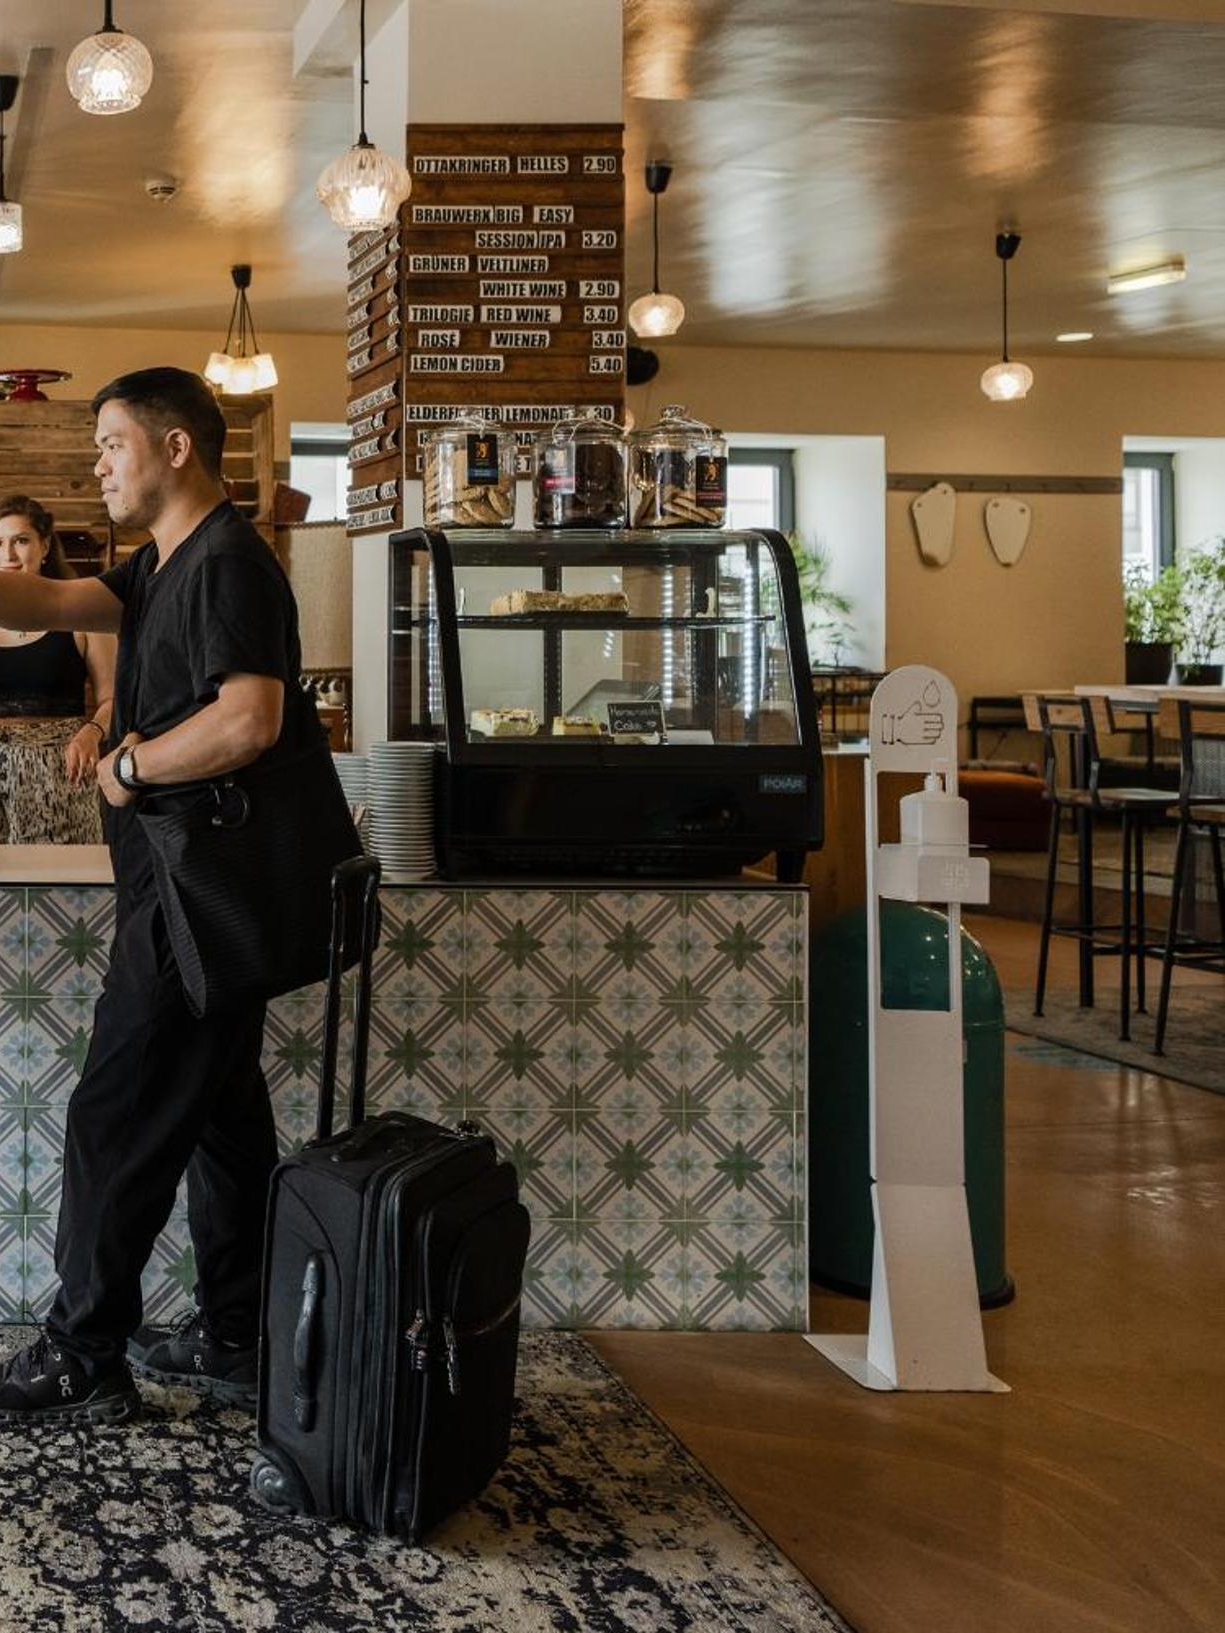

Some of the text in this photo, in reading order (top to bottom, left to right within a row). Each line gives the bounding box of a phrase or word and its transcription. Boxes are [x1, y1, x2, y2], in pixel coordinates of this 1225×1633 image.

[415, 157, 615, 173] OTTAKRINGER HELLES 2.90
[415, 208, 571, 222] BRAUWERK BIG EASY
[478, 233, 614, 248] SESSION IPA 3.20
[479, 257, 546, 272] VELTLINER
[482, 282, 616, 297] WHITE WINE 2.90
[412, 307, 472, 322] TRILOGIE
[486, 308, 512, 321] RED
[516, 308, 551, 321] WINE
[586, 308, 616, 321] 3.40
[495, 333, 548, 347] WIENER
[594, 332, 624, 346] 3.40
[412, 357, 622, 372] LEMON CIDER 5.40
